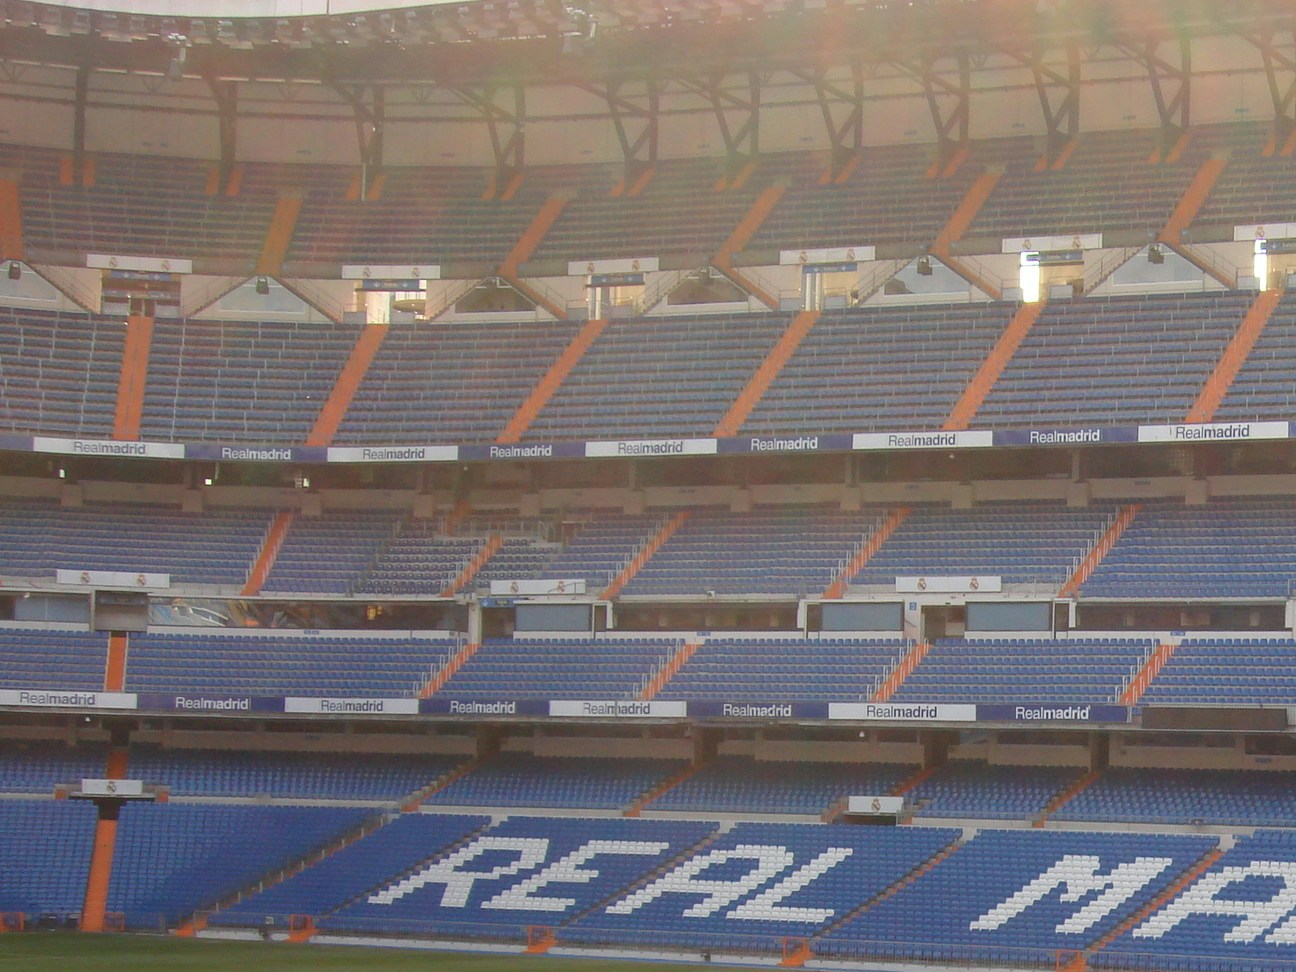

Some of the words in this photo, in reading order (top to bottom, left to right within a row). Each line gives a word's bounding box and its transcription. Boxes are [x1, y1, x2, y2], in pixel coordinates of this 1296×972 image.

[1029, 429, 1101, 444] Realmadrid
[1175, 424, 1250, 440] Realmadrid
[750, 437, 818, 451] Realmadrid
[887, 433, 956, 447] Realmadrid
[74, 441, 146, 455] Realmadrid
[221, 446, 292, 461] Realmadrid
[362, 447, 426, 461] Realmadrid
[490, 445, 552, 458] Realmadrid
[617, 441, 683, 454] Realmadrid
[19, 692, 96, 707] Realmadrid
[175, 697, 249, 711] Realmadrid
[320, 700, 384, 713] Realmadrid
[449, 701, 516, 714] Realmadrid
[722, 704, 792, 718] Realmadrid
[866, 705, 938, 719] Realmadrid
[1015, 706, 1089, 720] Realmadrid
[368, 835, 854, 924] REAL
